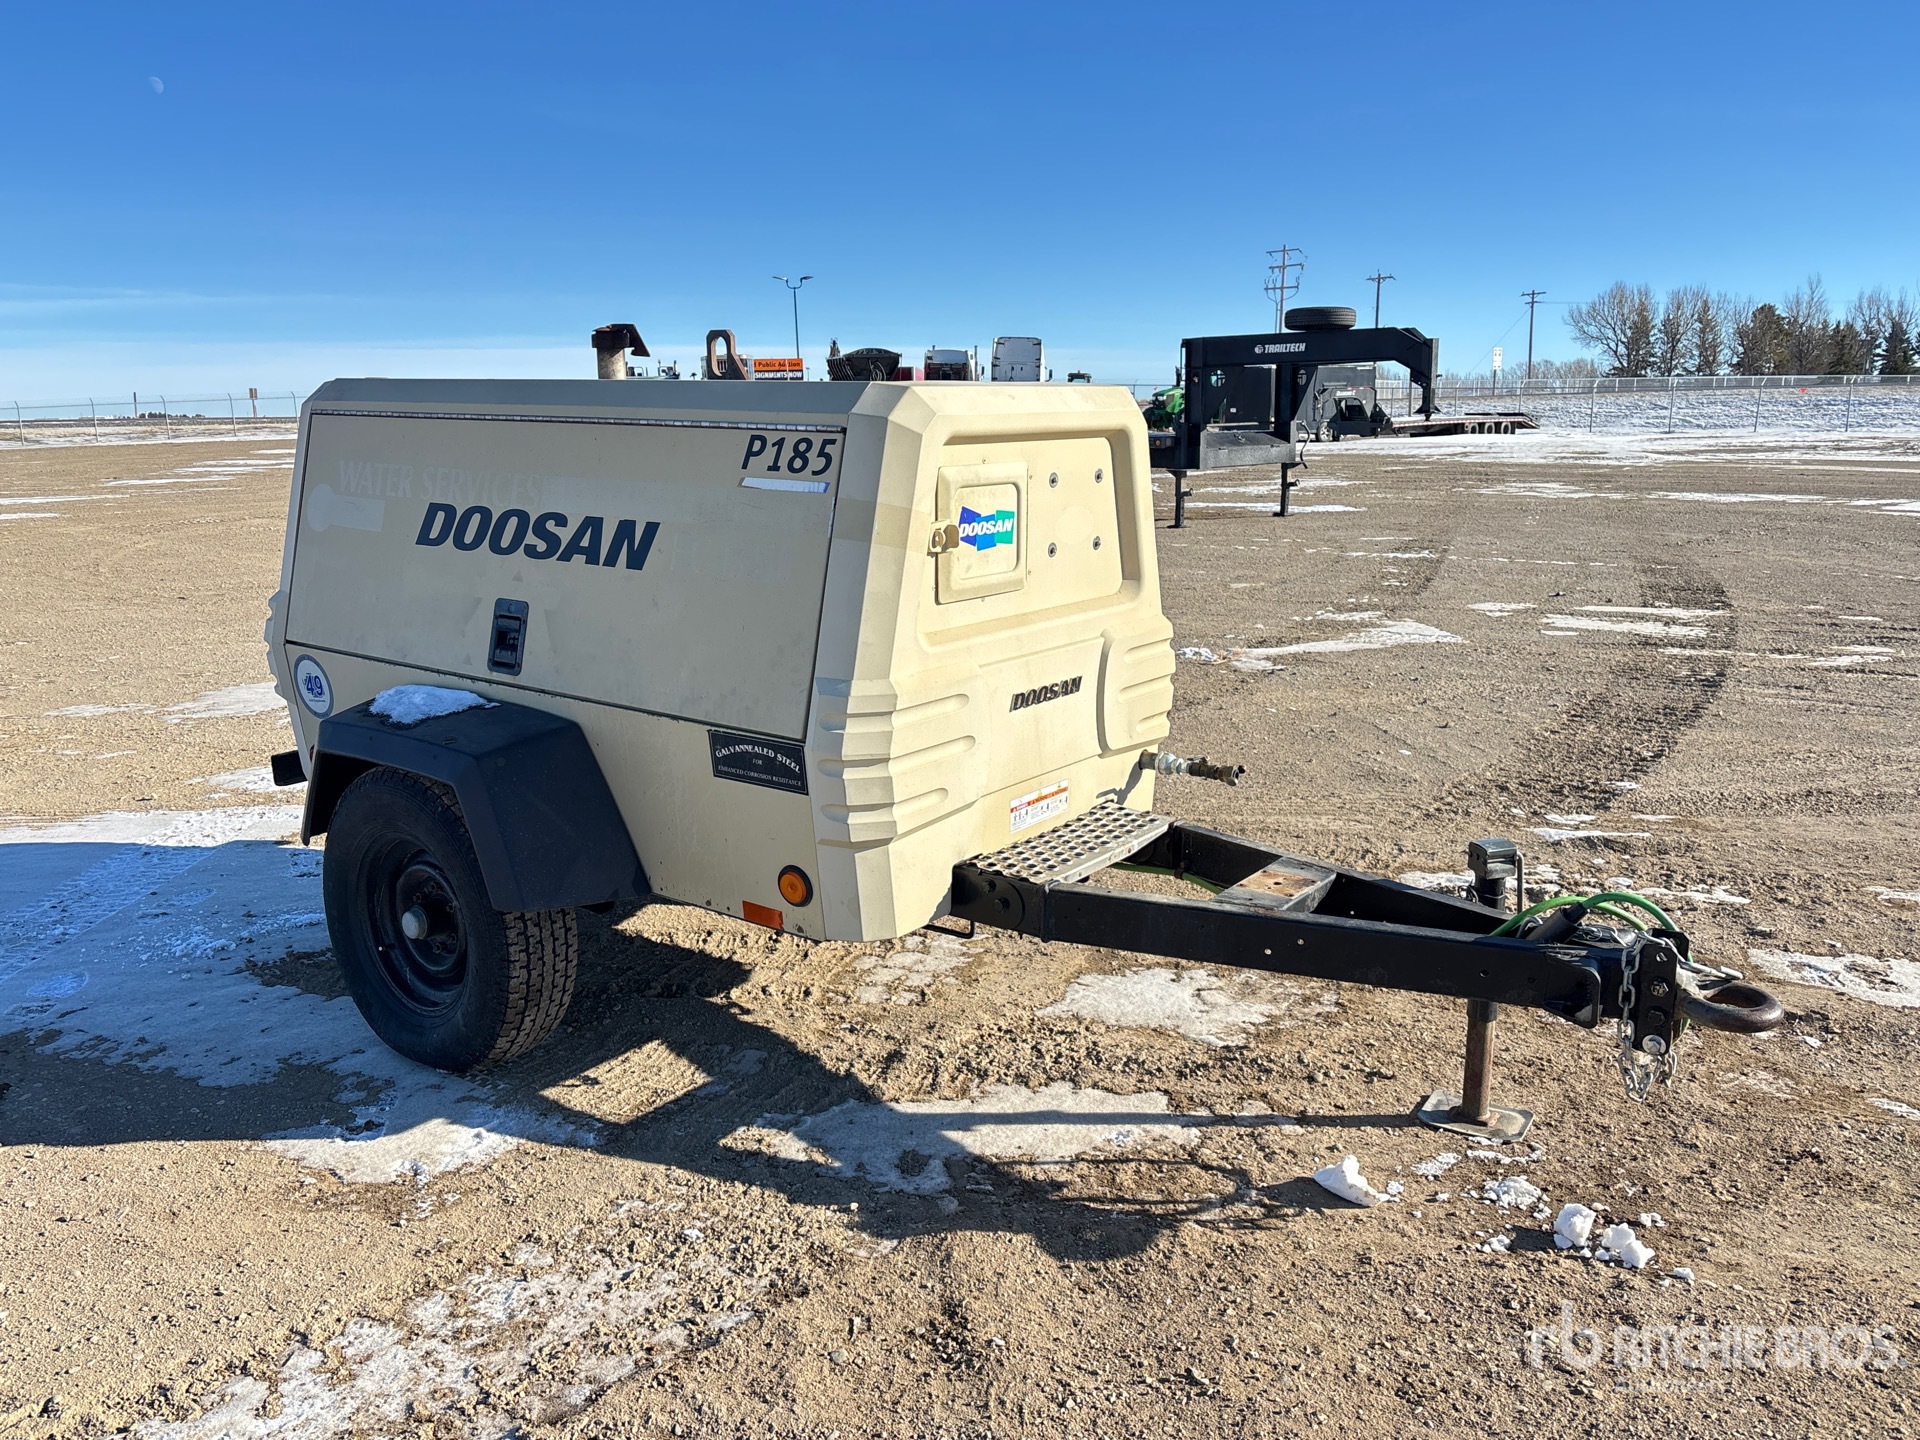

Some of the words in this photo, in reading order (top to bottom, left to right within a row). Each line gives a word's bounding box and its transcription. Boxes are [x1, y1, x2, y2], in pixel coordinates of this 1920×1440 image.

[1264, 342, 1306, 353] TRAILTECH
[741, 434, 838, 476] P185
[338, 459, 414, 499] WATER
[415, 502, 660, 571] DOOSAN
[959, 518, 1014, 538] DOOSAN
[306, 675, 323, 696] 49
[1009, 676, 1083, 713] DOOSAN
[715, 744, 775, 758] GALVANNEALED
[776, 753, 801, 774] STEEL
[718, 765, 744, 775] ENHANCED
[744, 768, 772, 781] CORROSION
[772, 775, 802, 786] RESISTANCE
